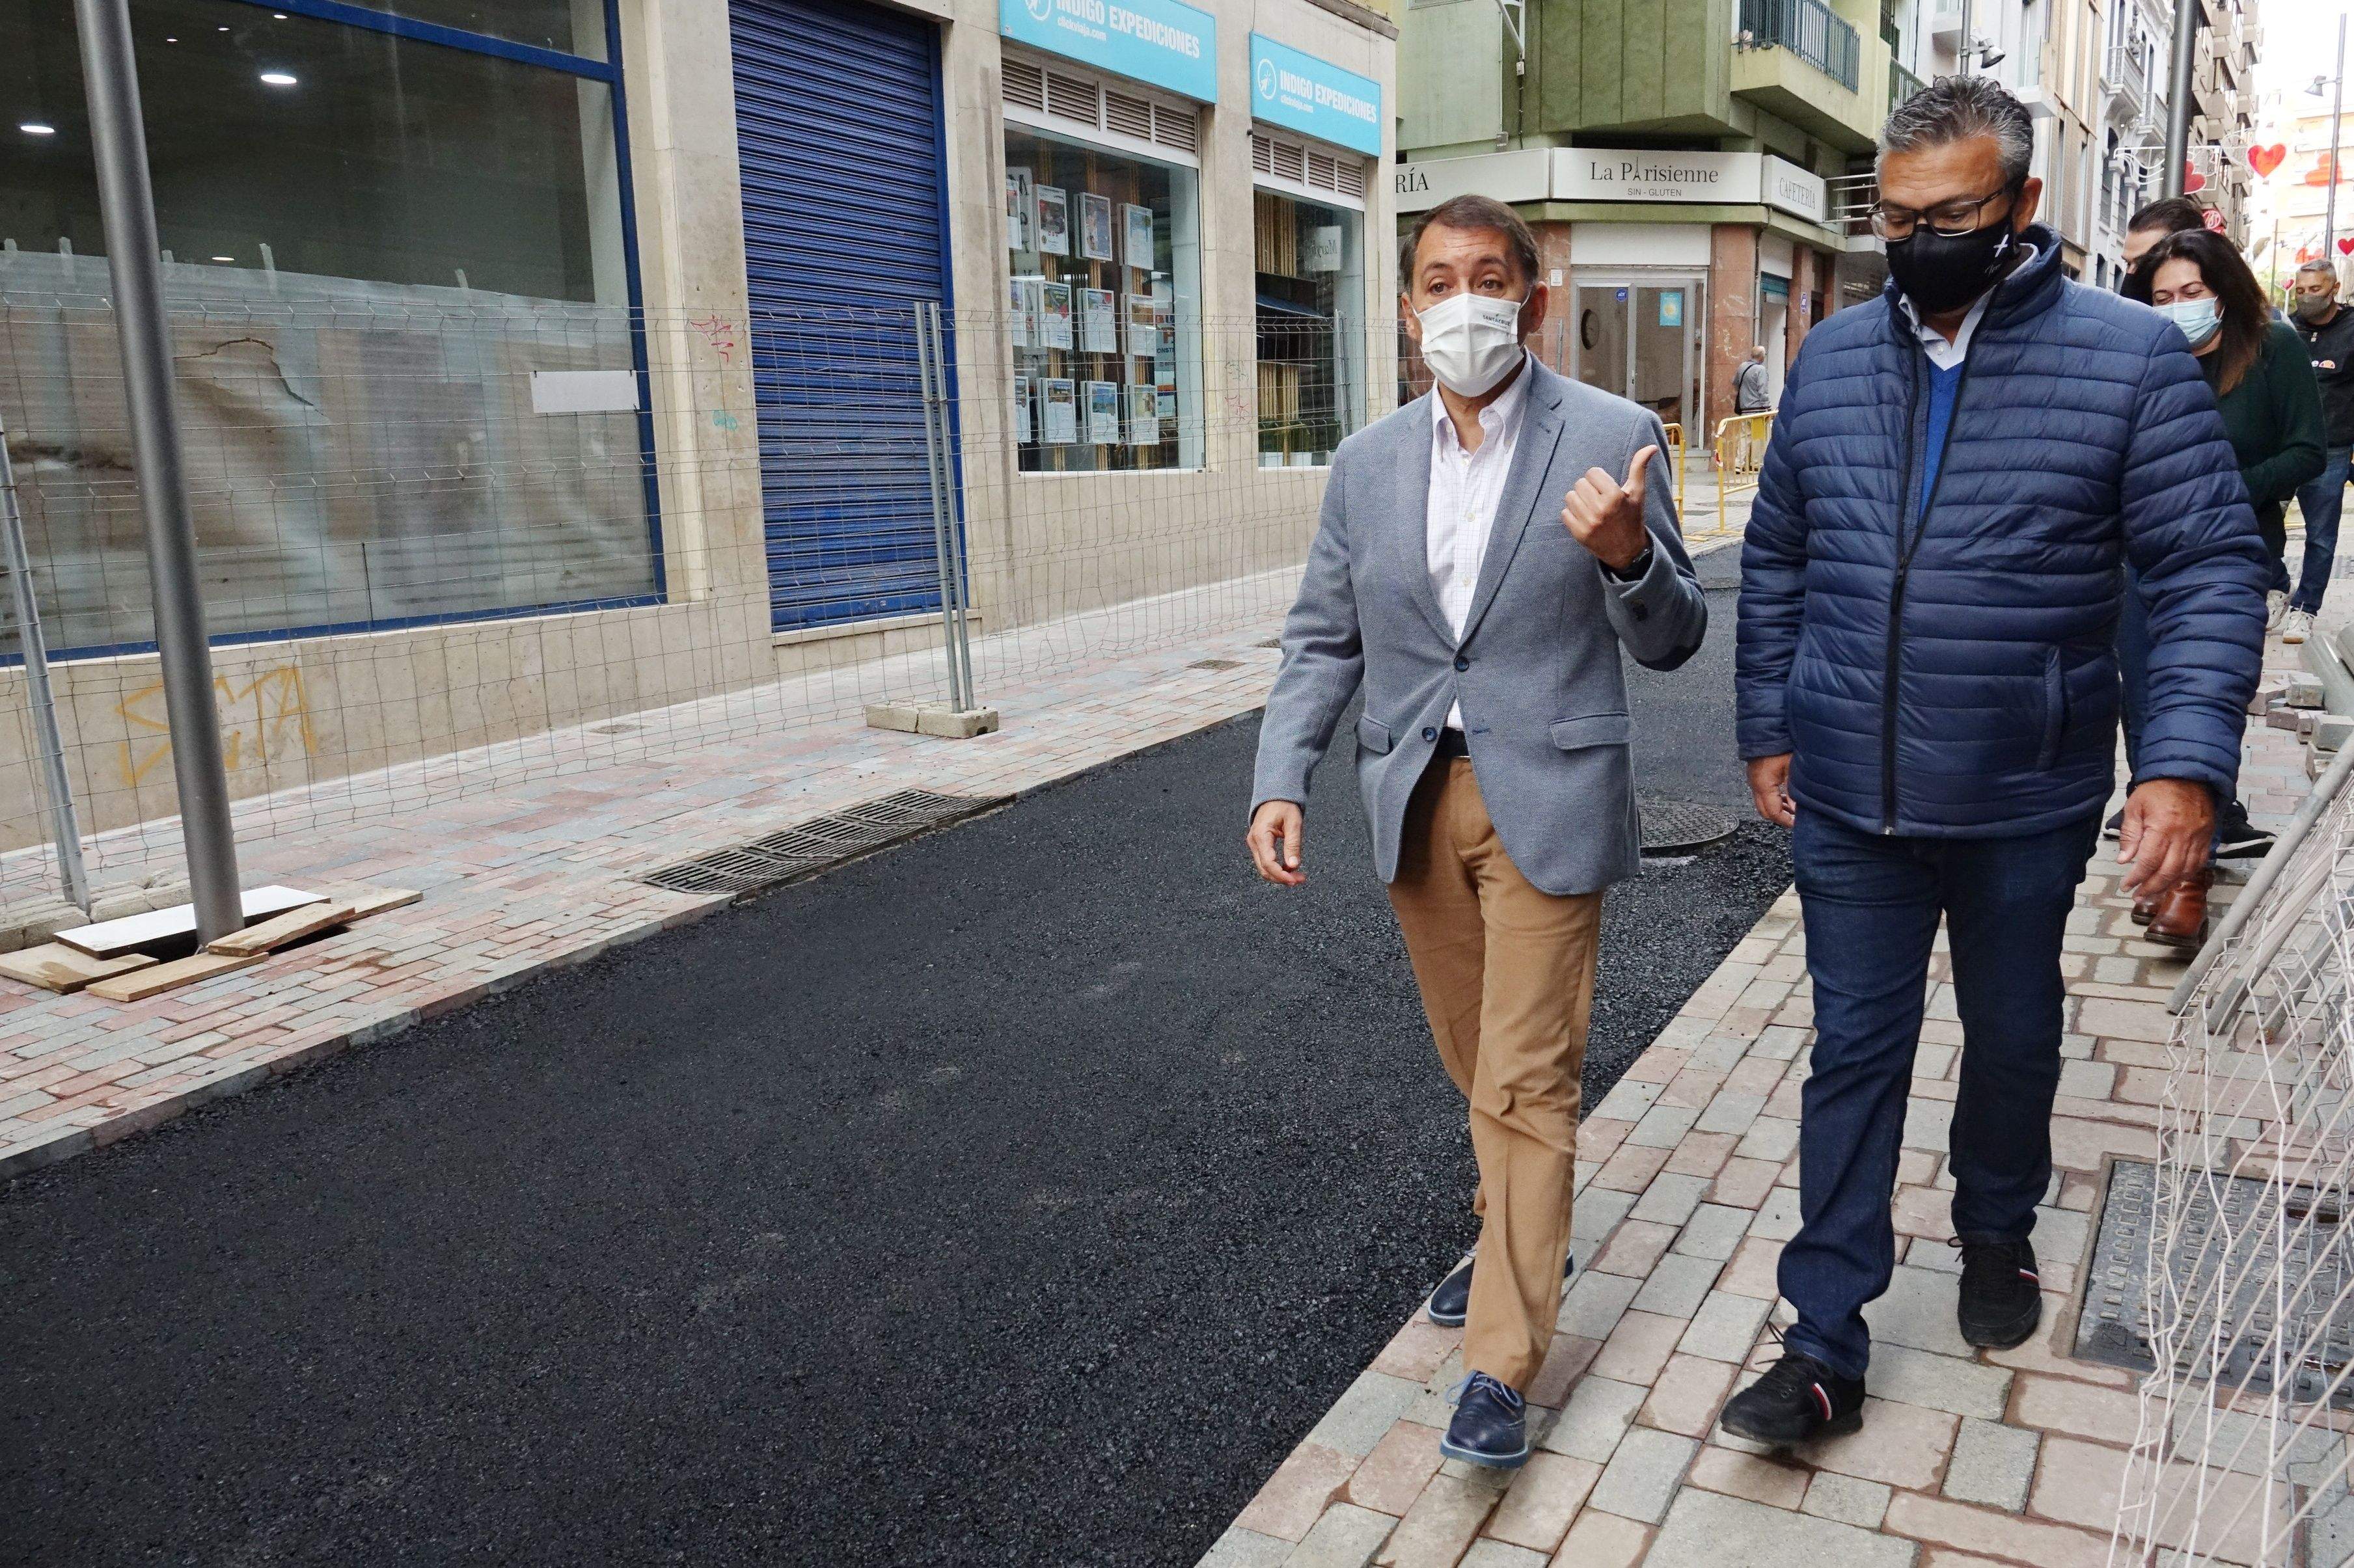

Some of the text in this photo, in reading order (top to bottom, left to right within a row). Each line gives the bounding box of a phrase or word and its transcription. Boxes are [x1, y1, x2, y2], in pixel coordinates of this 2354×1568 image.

[1109, 5, 1200, 59] EXPEDICIONES
[1280, 70, 1377, 124] INDIGO EXPEDICIONES
[1590, 161, 1613, 181] La
[1649, 188, 1682, 197] GLUTEN
[1779, 177, 1815, 210] CAFETERÍA
